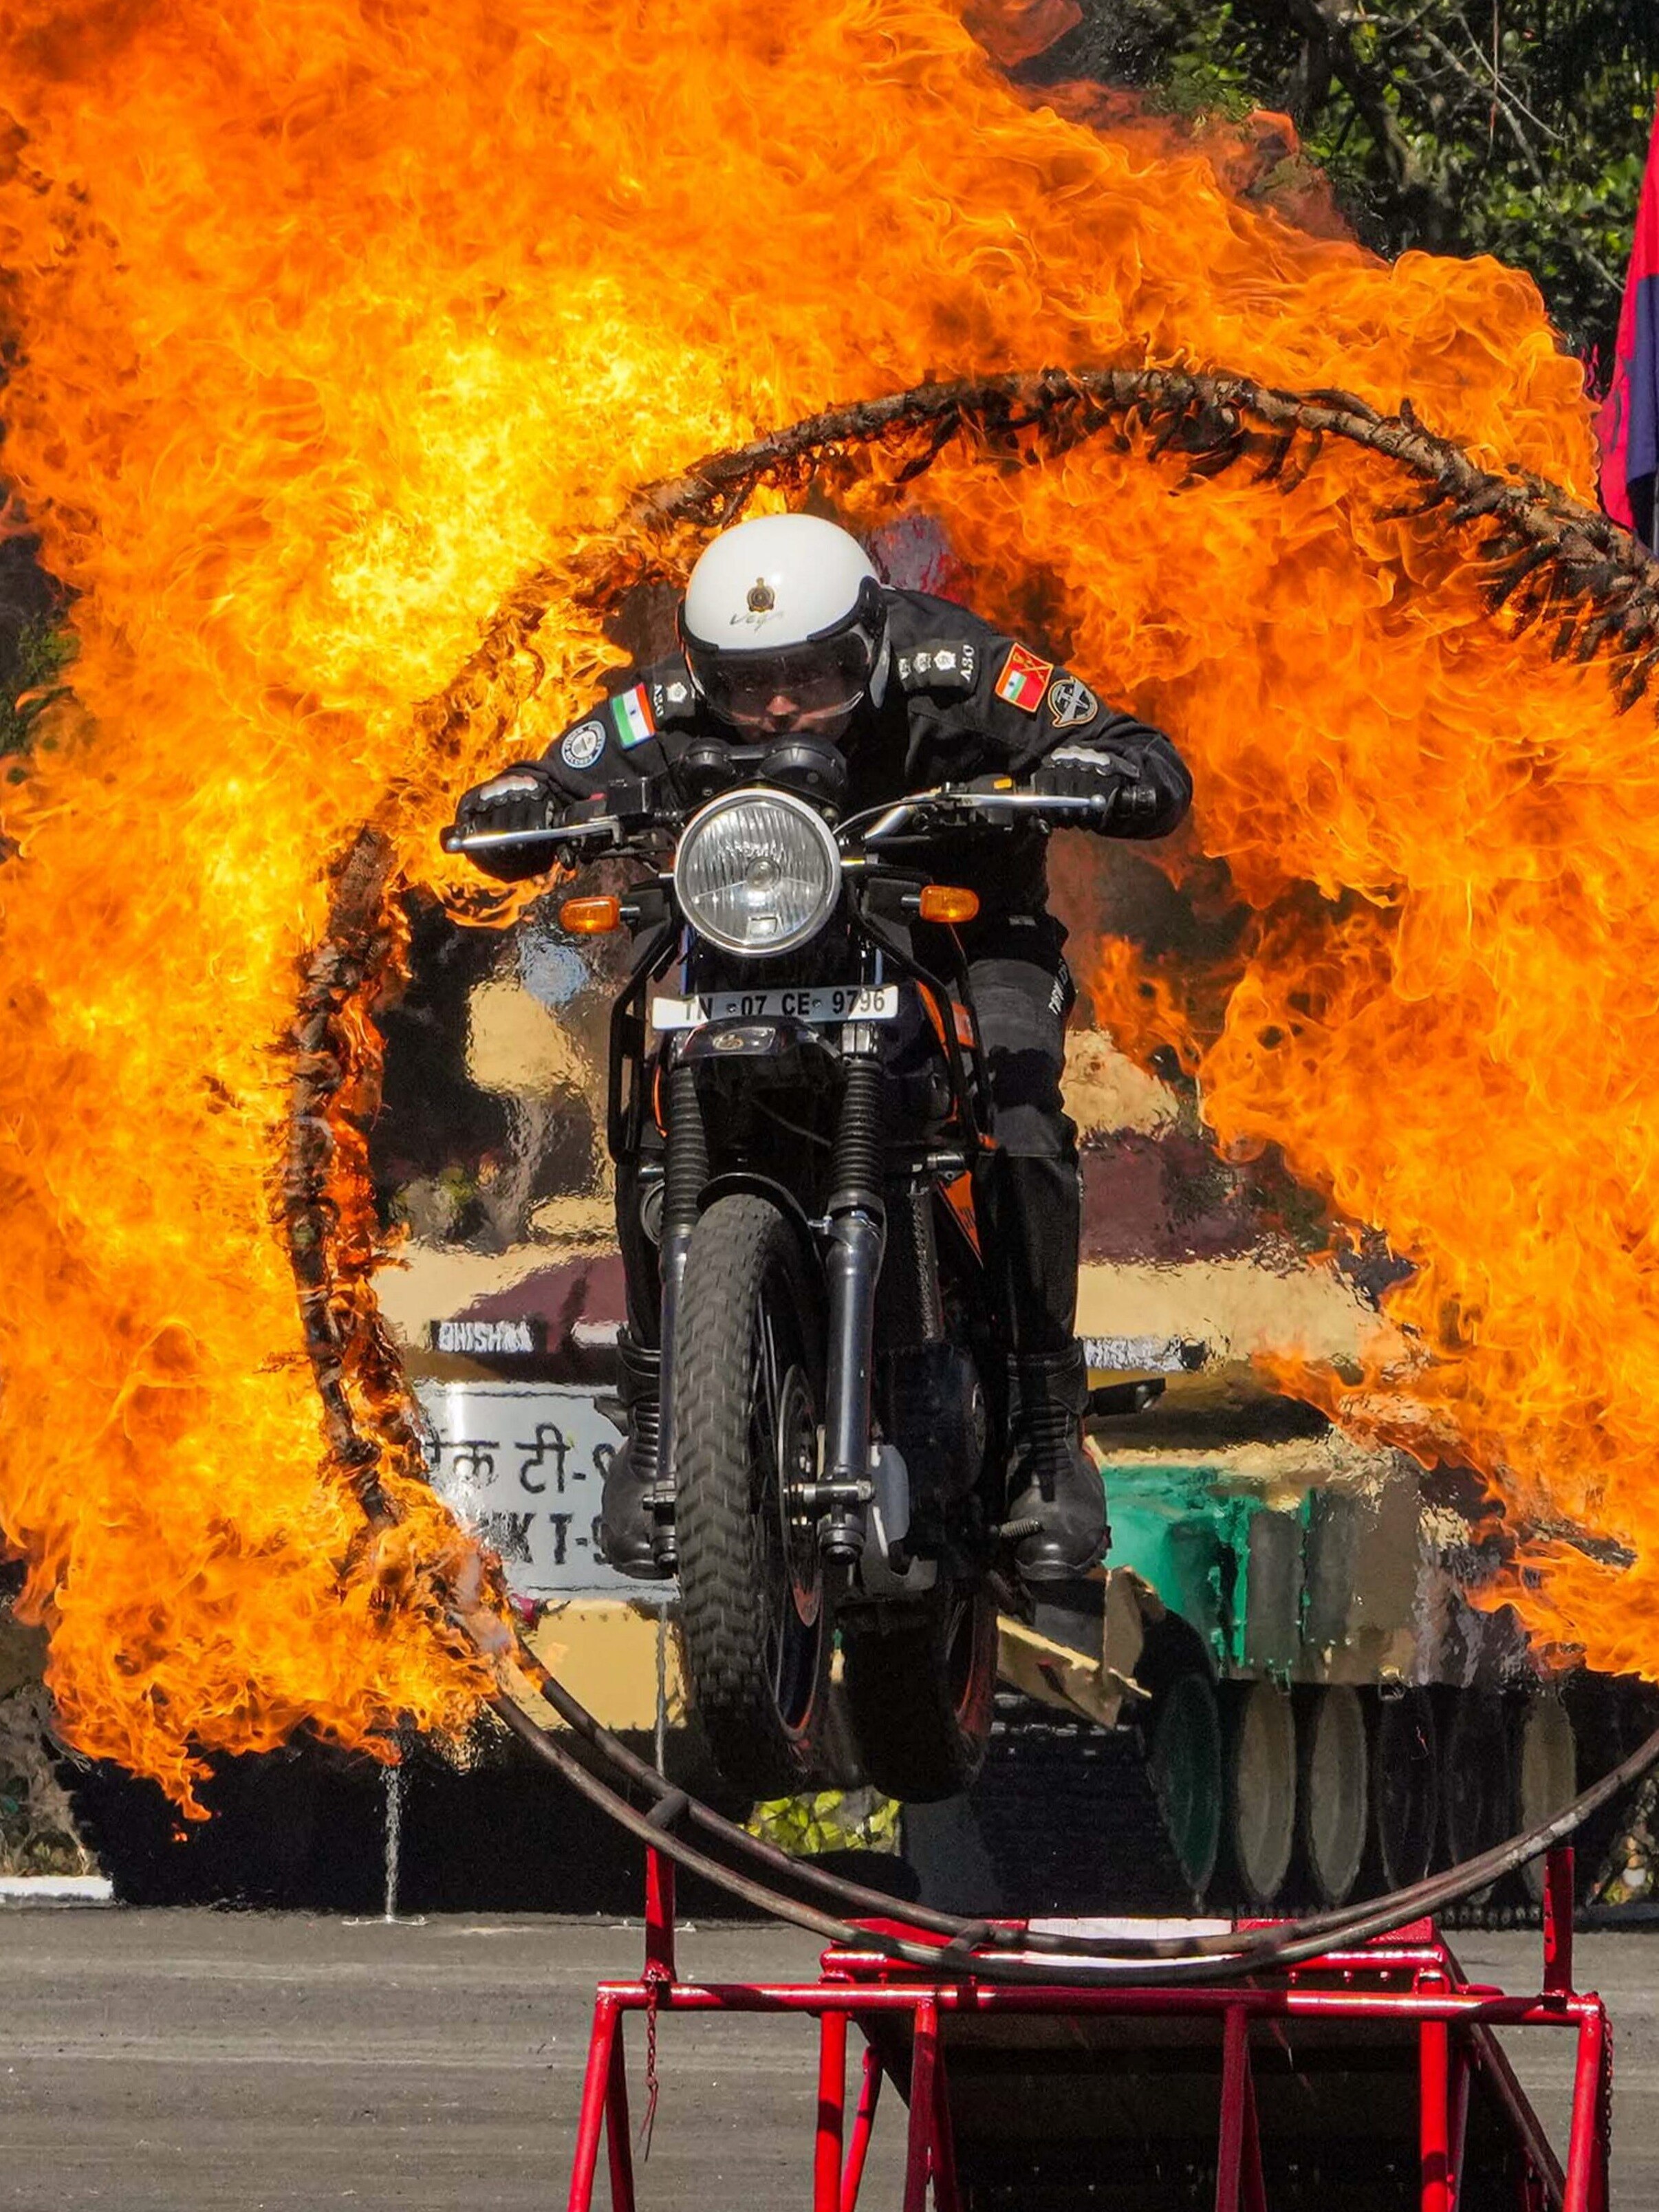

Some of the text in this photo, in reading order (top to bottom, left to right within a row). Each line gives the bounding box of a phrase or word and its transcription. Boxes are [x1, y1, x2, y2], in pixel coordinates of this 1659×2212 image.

[741, 995, 768, 1015] 07
[782, 992, 810, 1015] CE
[832, 988, 885, 1015] 9796
